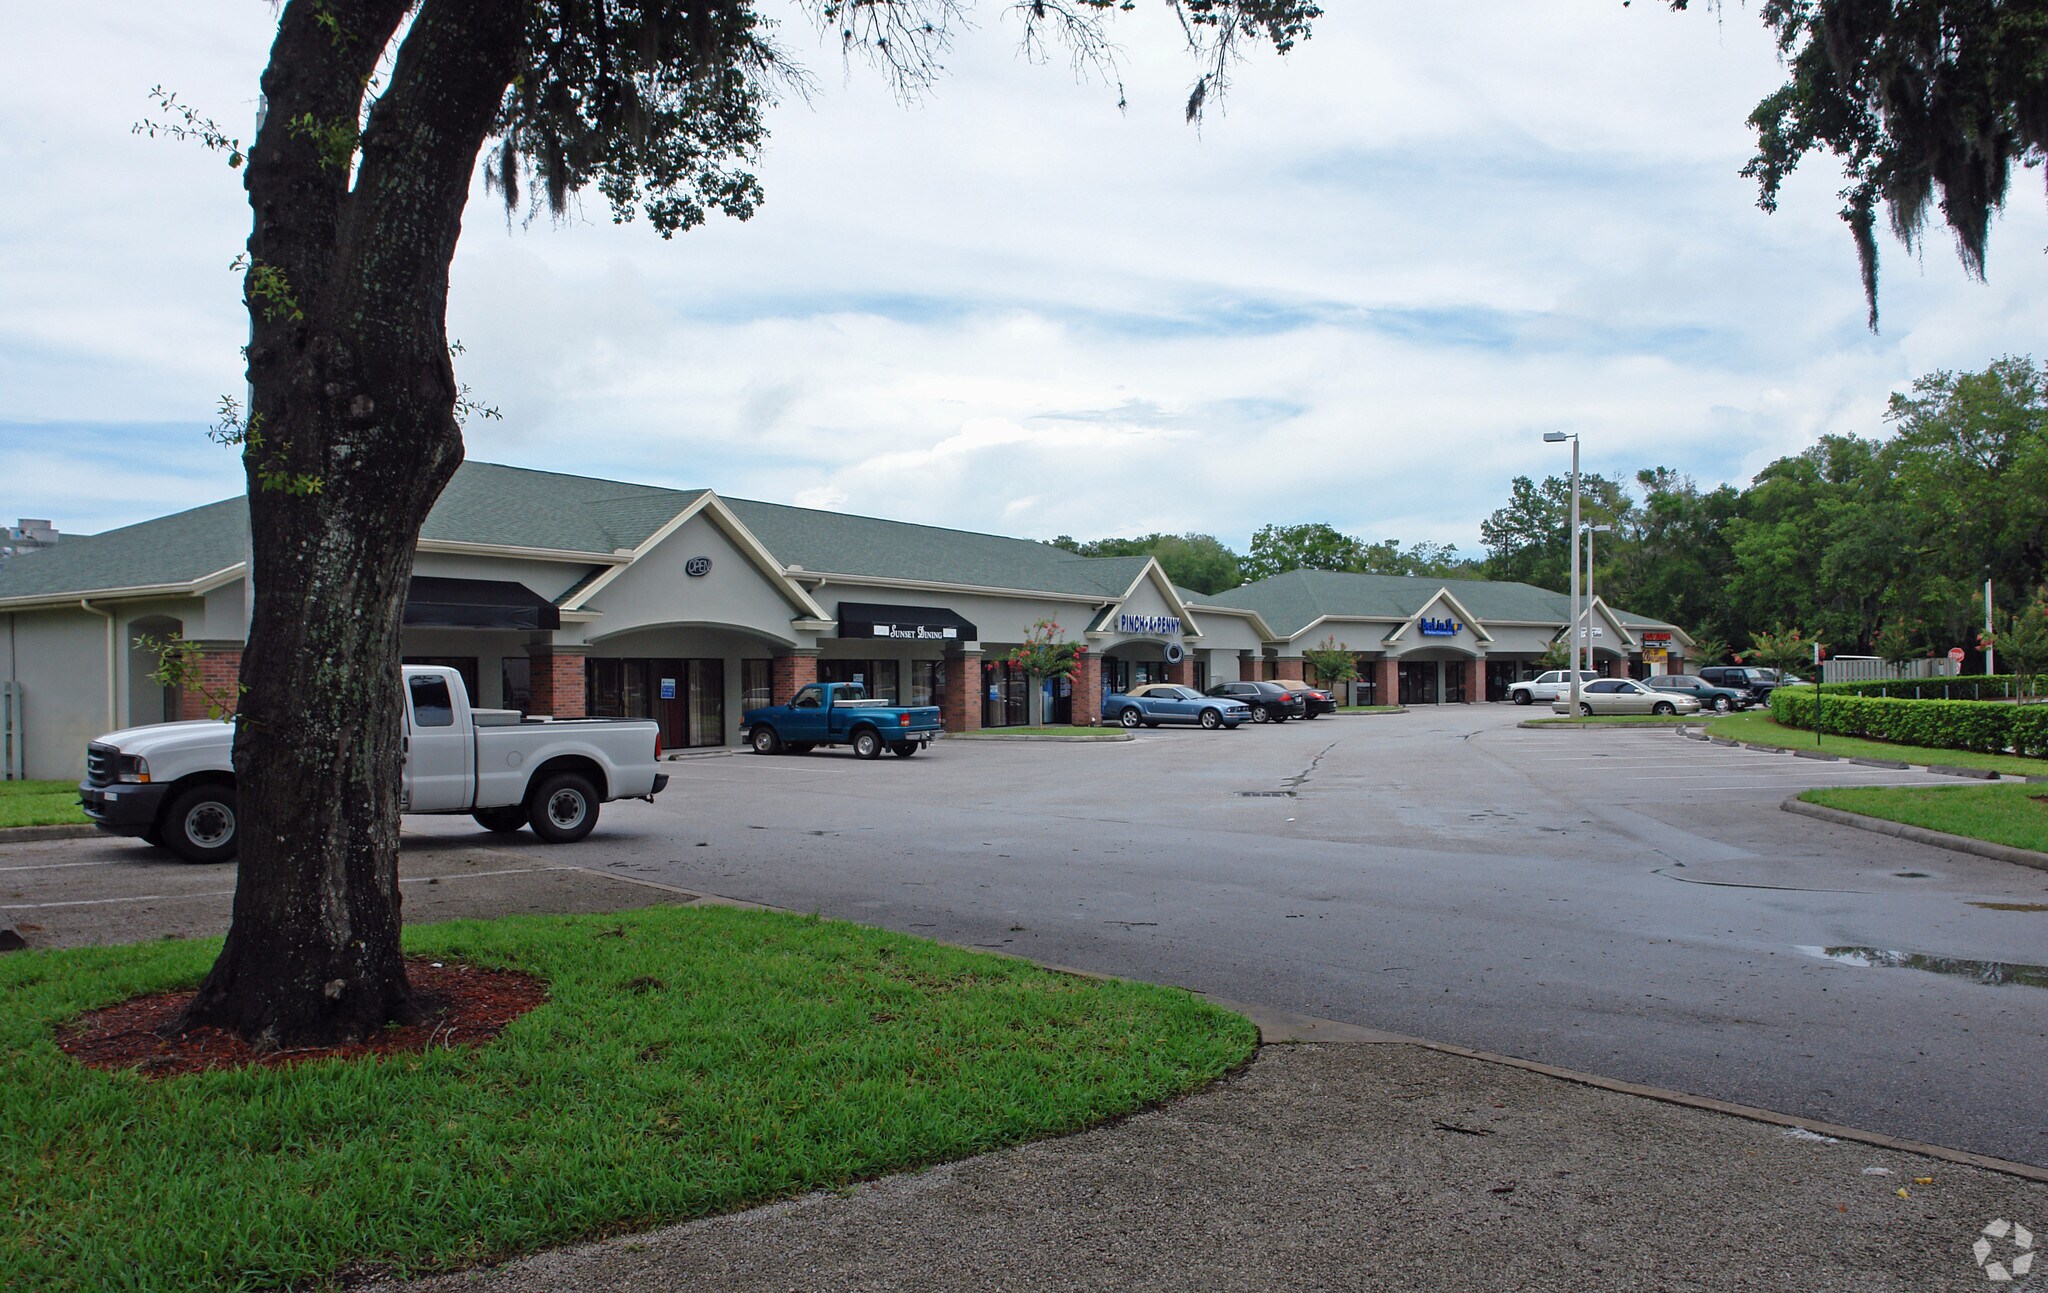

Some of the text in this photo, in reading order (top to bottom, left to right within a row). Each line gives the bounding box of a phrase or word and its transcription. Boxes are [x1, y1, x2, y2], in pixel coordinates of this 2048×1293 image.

[688, 559, 710, 572] OPEN
[890, 624, 943, 640] SUNSET DINING
